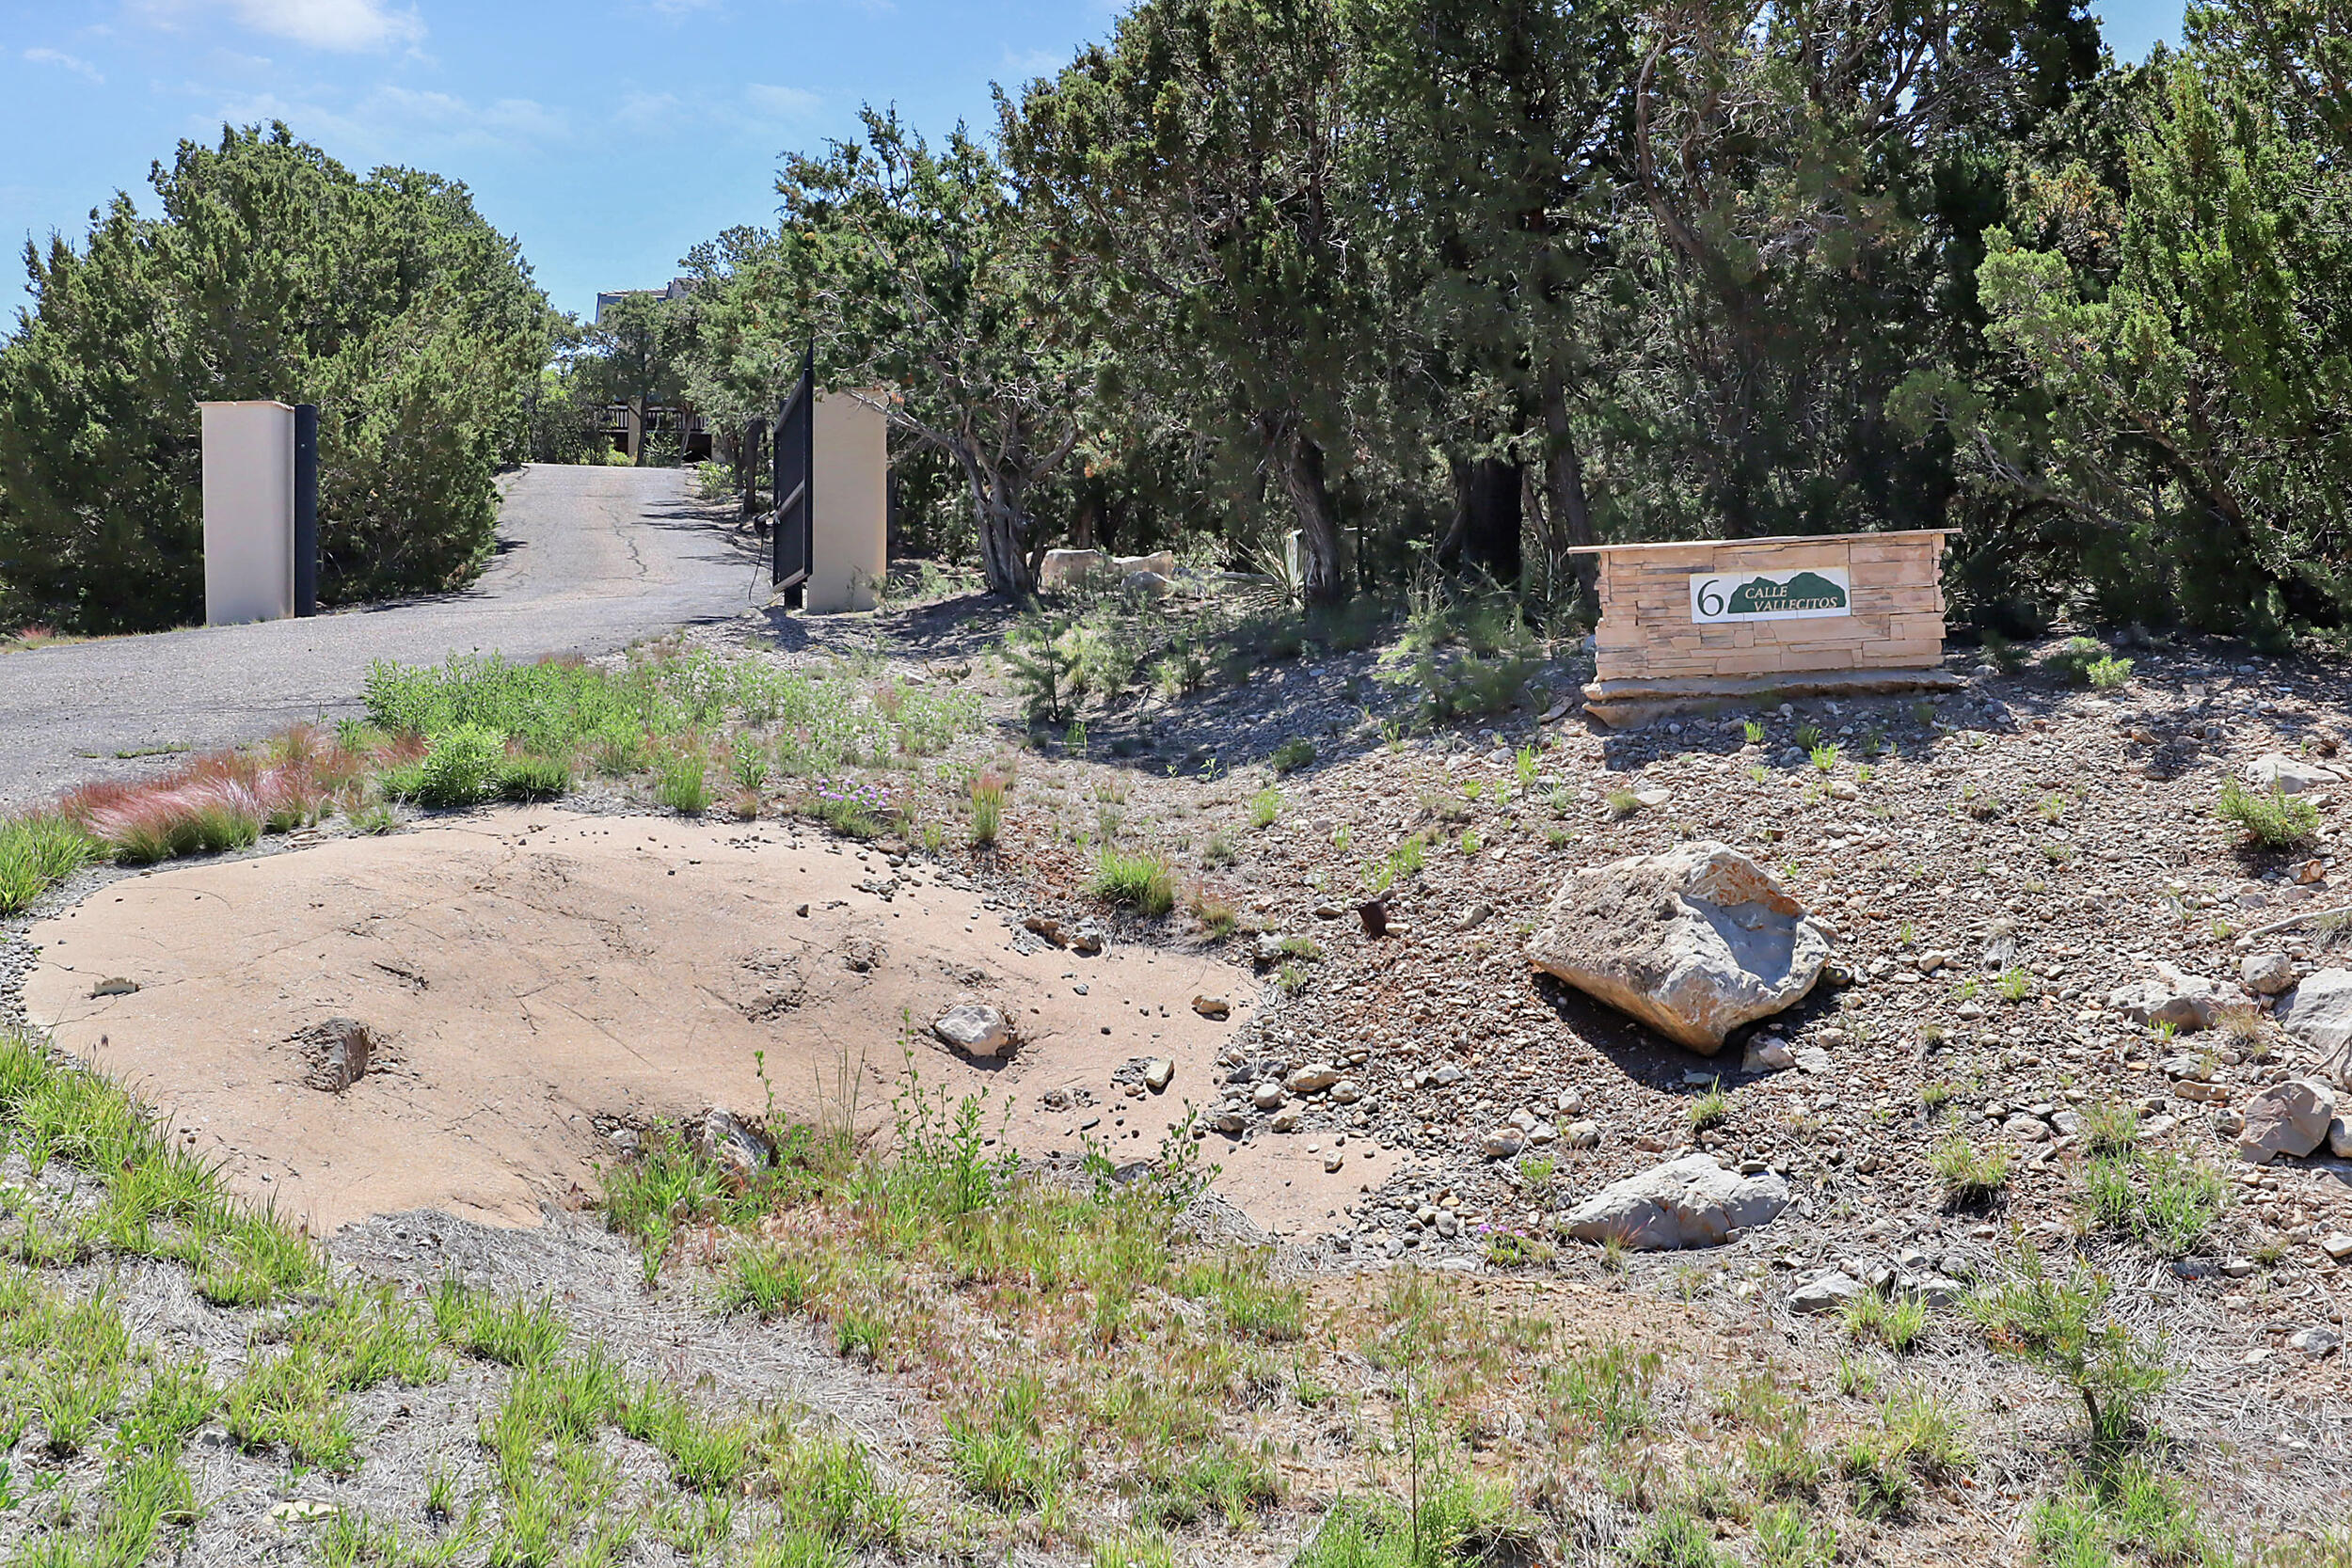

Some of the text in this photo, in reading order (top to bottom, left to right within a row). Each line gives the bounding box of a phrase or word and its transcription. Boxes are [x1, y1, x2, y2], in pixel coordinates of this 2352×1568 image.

[1697, 579, 1724, 617] 6
[1745, 586, 1788, 599] CALLE
[1754, 596, 1838, 611] VALLECITOS
